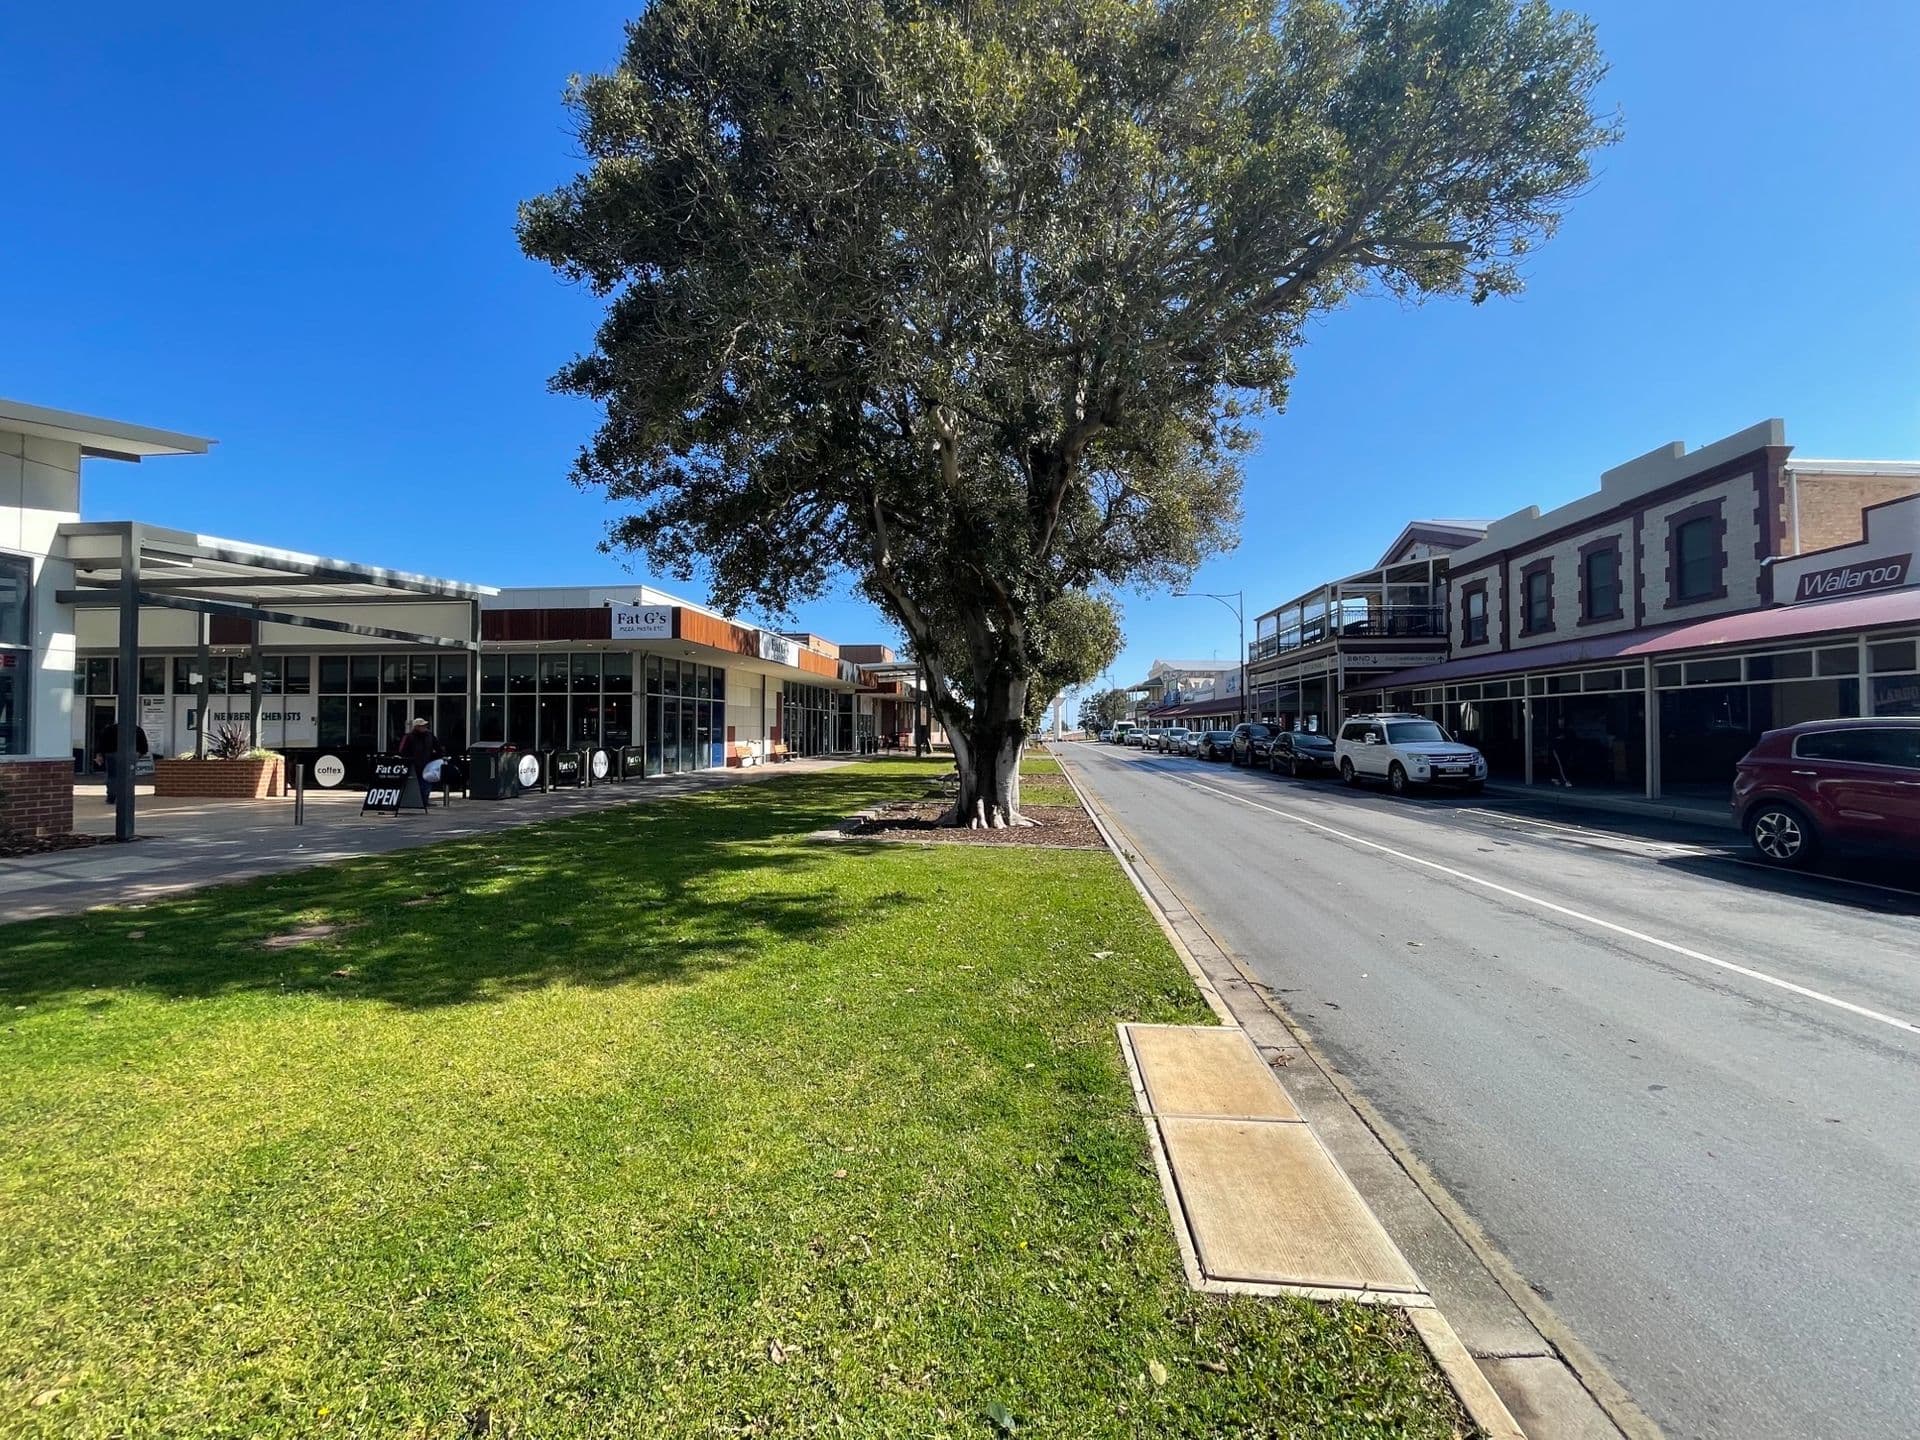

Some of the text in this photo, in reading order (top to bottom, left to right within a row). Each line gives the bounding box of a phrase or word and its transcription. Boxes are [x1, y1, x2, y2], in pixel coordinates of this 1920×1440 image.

[1805, 565, 1901, 595] Wallaroo
[617, 611, 667, 624] Fat G's
[375, 764, 408, 775] Fat G's
[367, 788, 400, 806] OPEN
